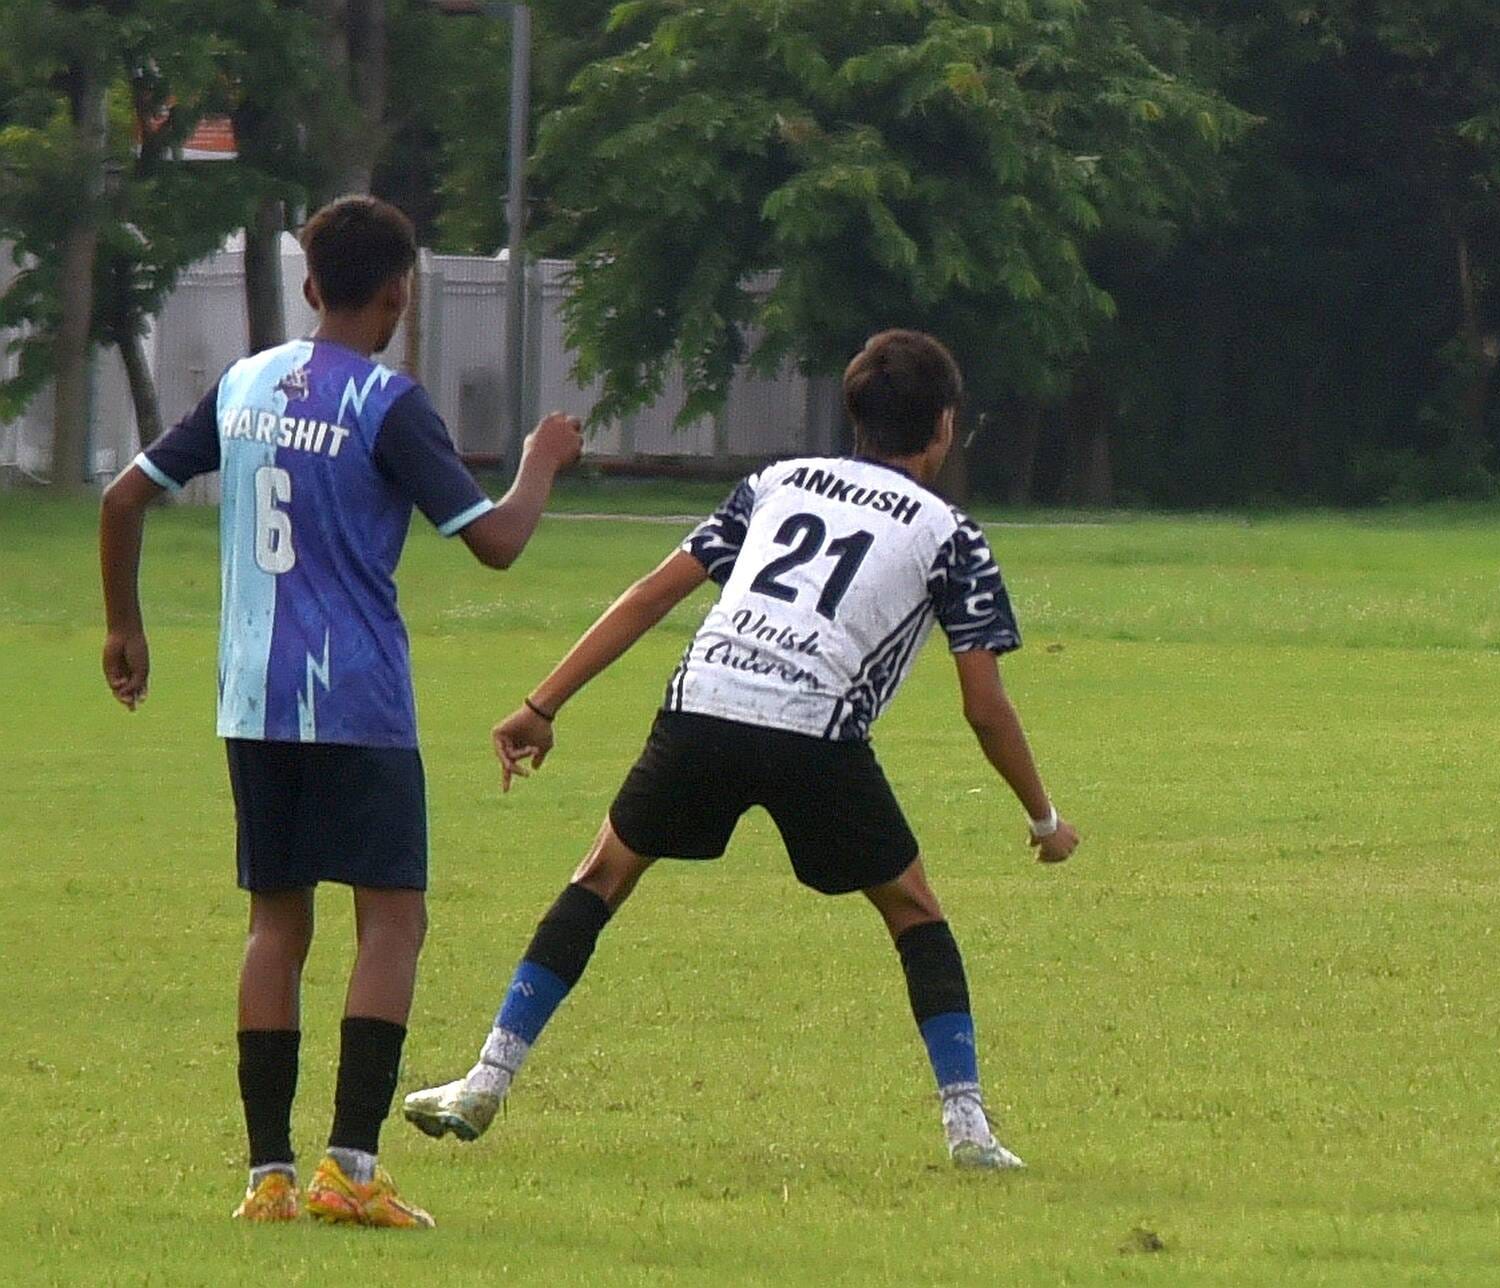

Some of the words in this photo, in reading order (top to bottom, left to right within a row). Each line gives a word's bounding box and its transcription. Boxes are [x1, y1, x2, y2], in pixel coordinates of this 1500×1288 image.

[222, 408, 349, 457] HARSHIT
[255, 466, 296, 574] 6
[783, 467, 922, 525] ANKUSH
[750, 513, 875, 621] 21
